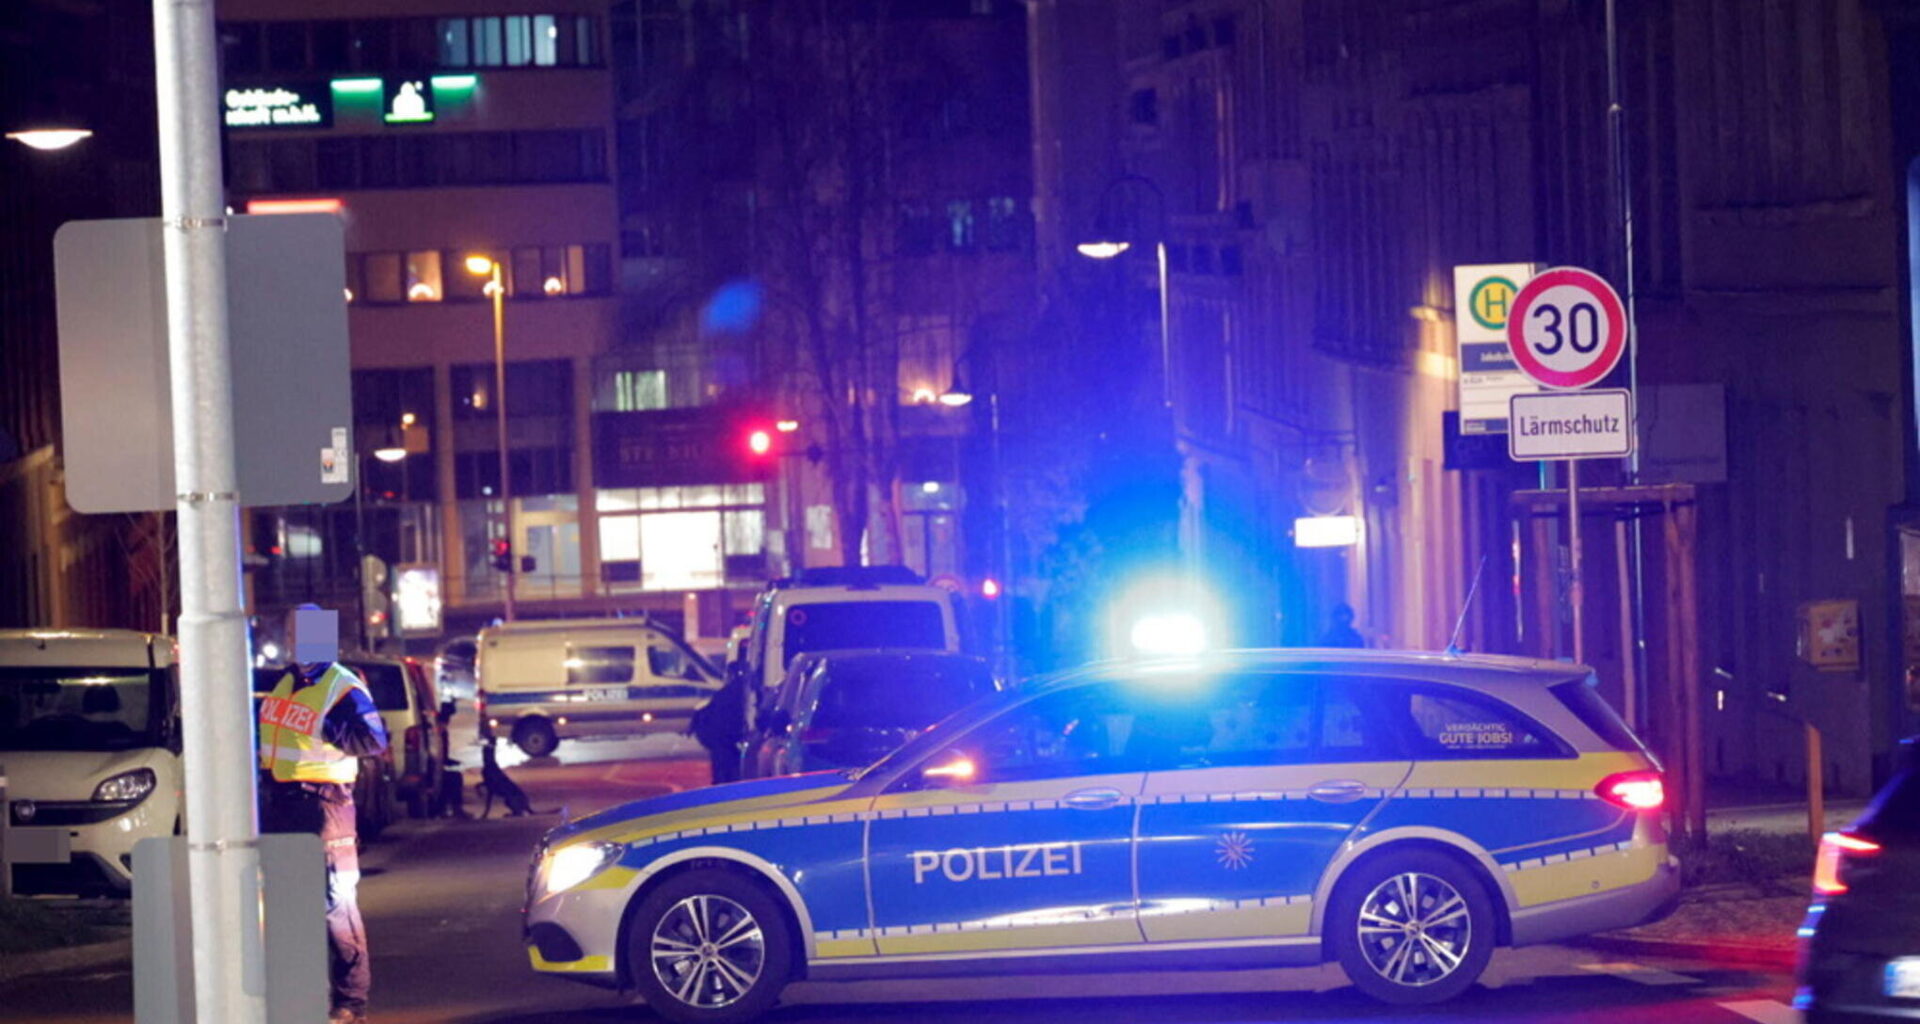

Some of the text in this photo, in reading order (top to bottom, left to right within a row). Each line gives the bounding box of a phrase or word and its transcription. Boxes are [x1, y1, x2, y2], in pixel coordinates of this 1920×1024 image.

[1485, 289, 1507, 318] H
[1533, 303, 1599, 355] 30
[1520, 415, 1619, 436] Lärmschutz
[1439, 732, 1513, 744] GUTE JOBS!
[913, 841, 1083, 884] POLIZEI
